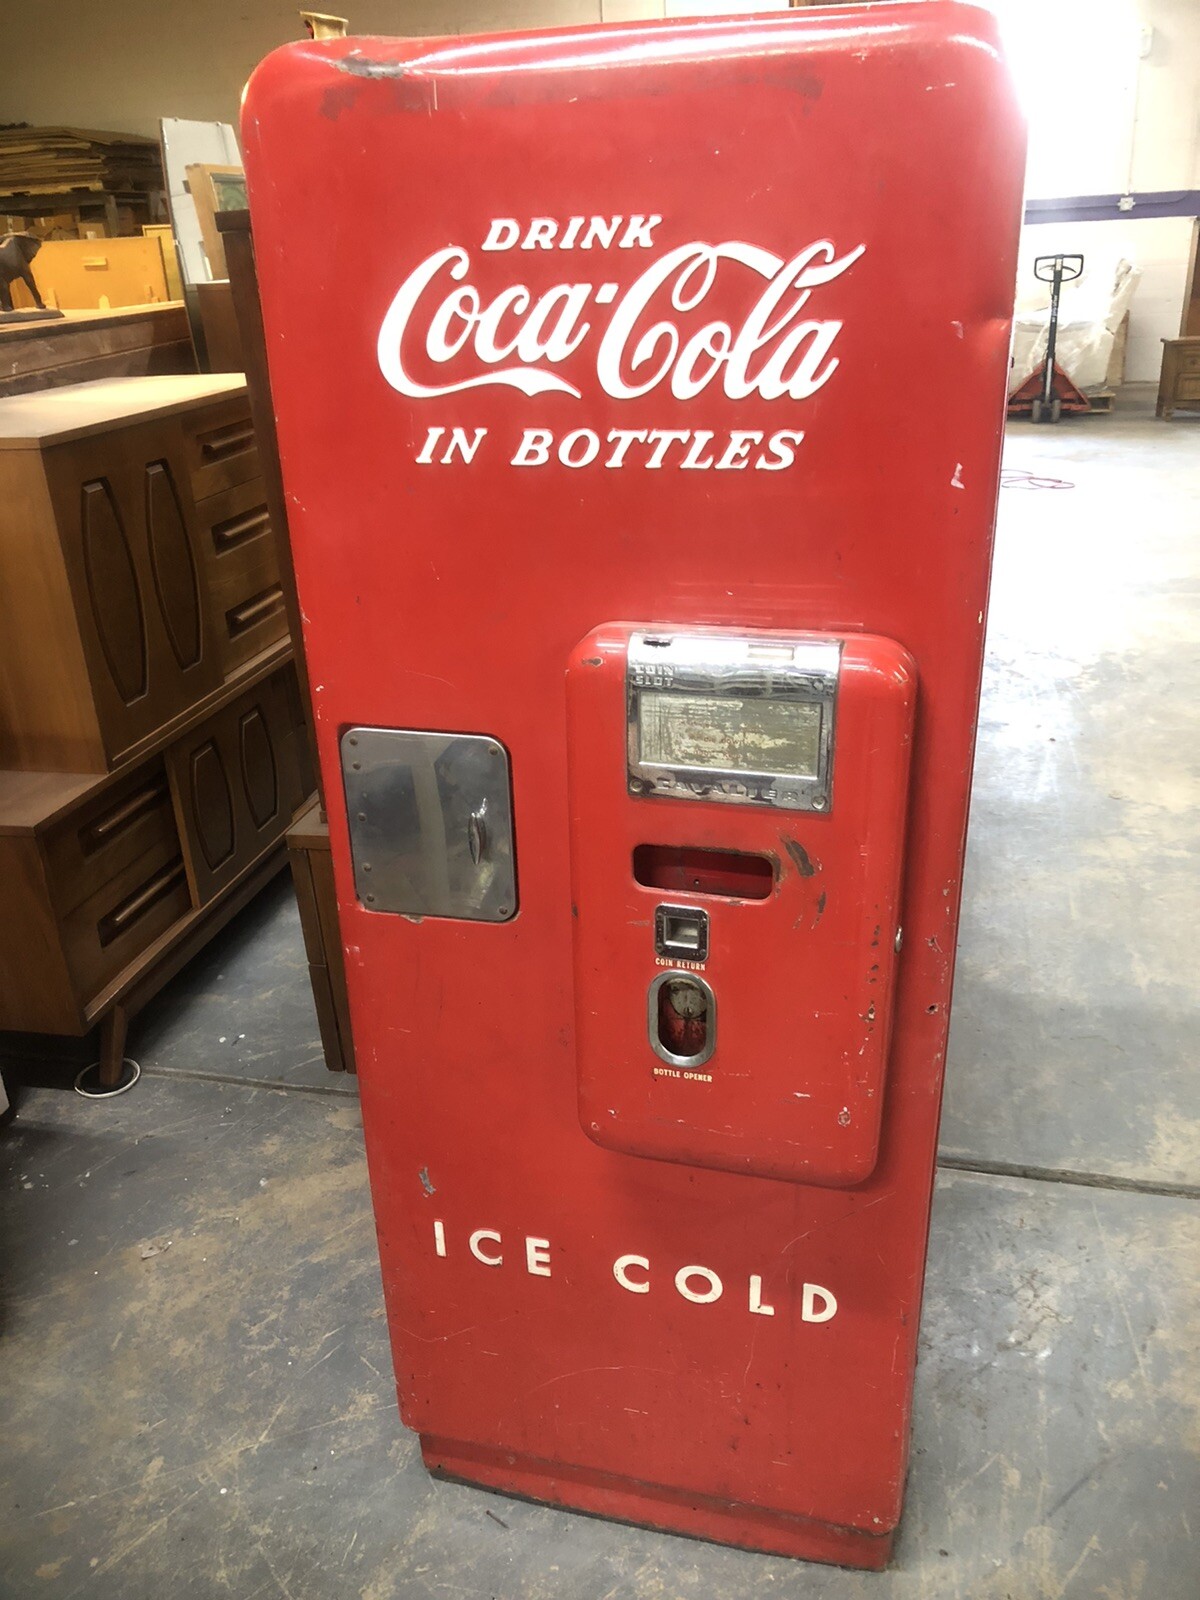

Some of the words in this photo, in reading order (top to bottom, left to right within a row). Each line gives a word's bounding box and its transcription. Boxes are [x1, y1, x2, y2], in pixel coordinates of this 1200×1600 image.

[481, 214, 662, 251] DRINK
[377, 239, 866, 401] Coca-Cola
[415, 427, 488, 464] IN
[510, 428, 804, 470] BOTTLES
[635, 675, 674, 686] SLOT
[655, 957, 673, 967] COIN
[676, 960, 706, 971] RETURN
[653, 1067, 681, 1078] BOTTLE
[683, 1071, 713, 1083] OPENER
[434, 1219, 552, 1277] ICE
[612, 1254, 838, 1323] COLD
